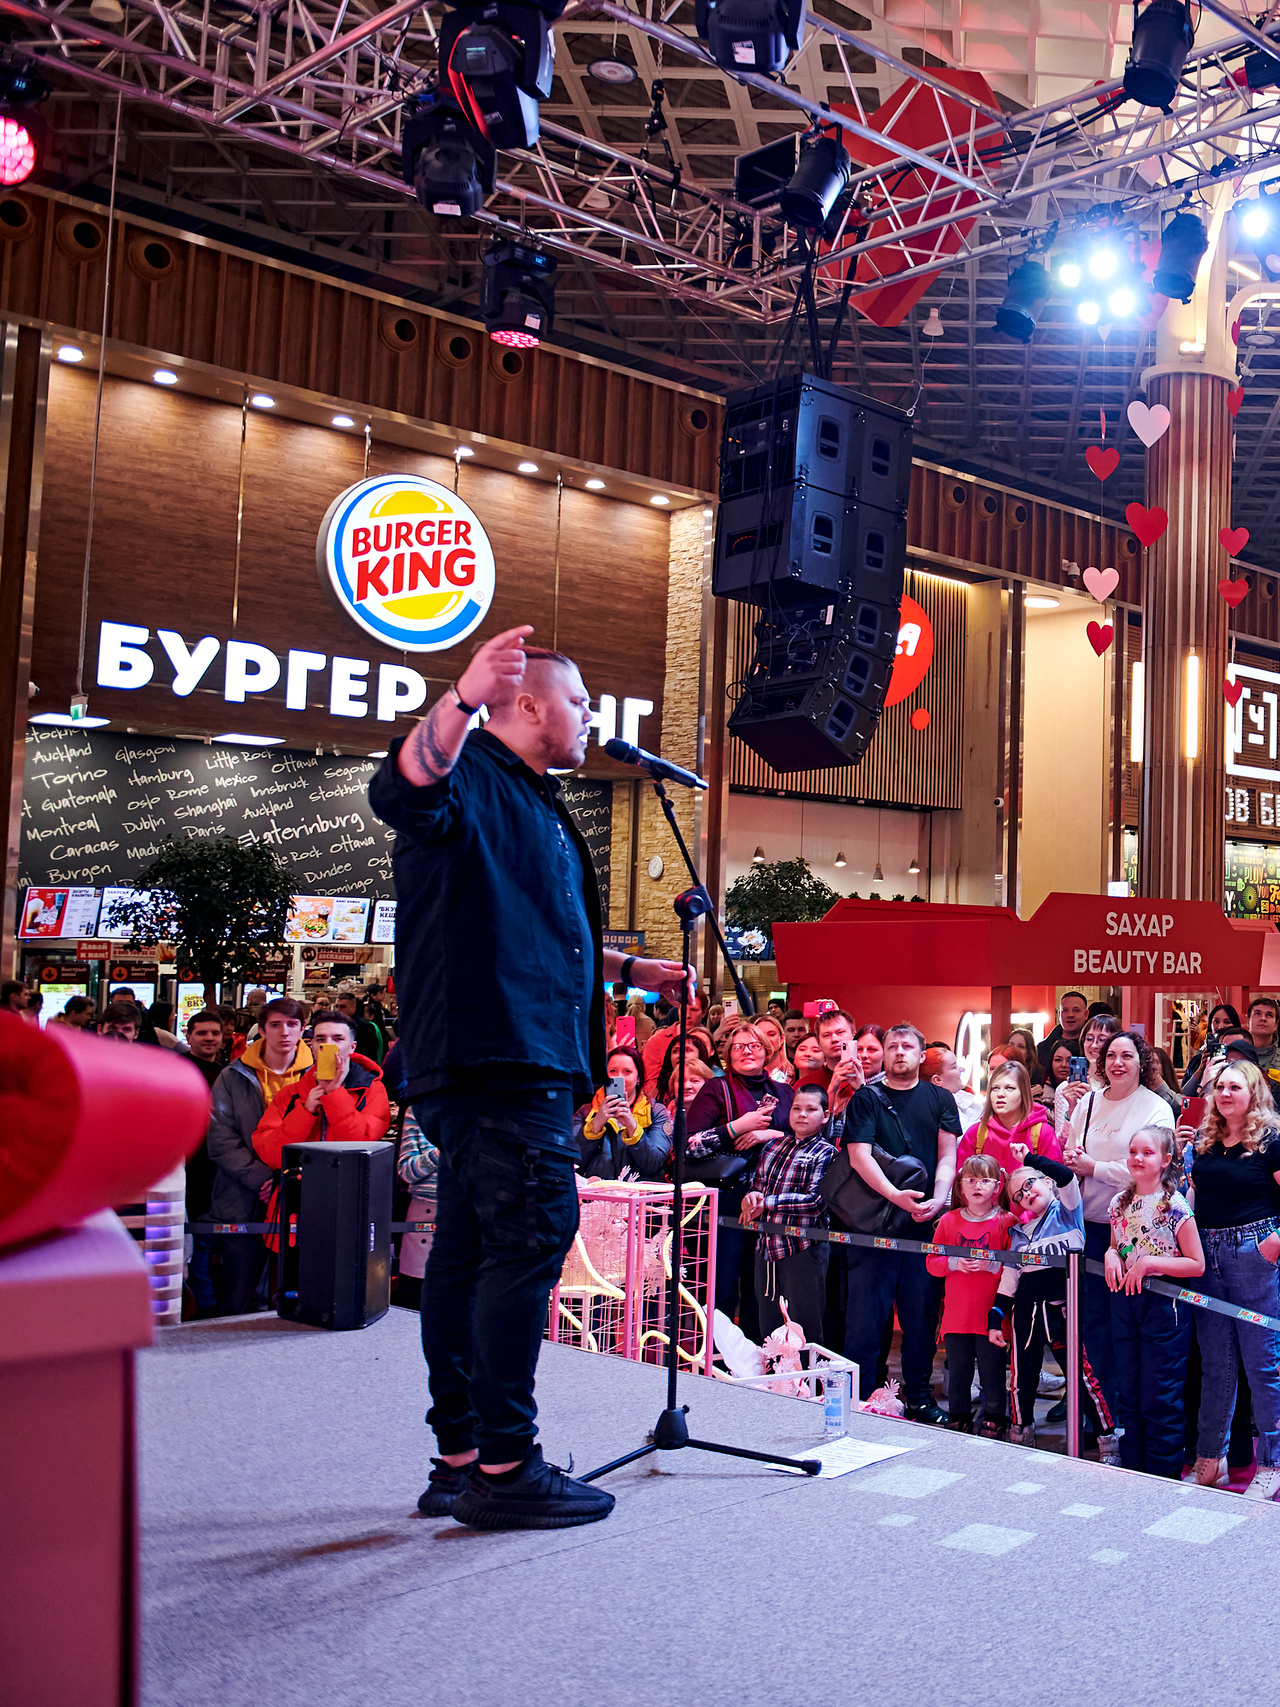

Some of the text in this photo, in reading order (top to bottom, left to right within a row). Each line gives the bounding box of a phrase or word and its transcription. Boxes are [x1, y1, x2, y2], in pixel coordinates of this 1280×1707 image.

[352, 520, 471, 559] BURGER
[356, 549, 476, 601] KING
[97, 621, 428, 722] БУРГЕР
[32, 743, 92, 763] Auckland
[115, 744, 176, 765] Glasgow
[205, 748, 275, 770] Little Rock
[271, 754, 318, 773] Ottawa
[31, 766, 108, 788] Torino
[128, 769, 194, 788] Hamburg
[215, 773, 257, 788] Mexico
[324, 760, 374, 781] Segovia
[165, 785, 209, 801] Rome
[250, 776, 309, 798] Innsbruck
[564, 790, 603, 803] Mexico
[41, 785, 117, 813] Guatemala
[127, 794, 160, 810] Oslo
[174, 793, 238, 820] Shanghai
[242, 797, 294, 819] Auckland
[569, 803, 610, 818] Torin
[26, 813, 100, 841] Montreal
[122, 815, 166, 834] Dublin
[182, 822, 226, 839] Paris
[50, 839, 119, 860] Caracas
[127, 839, 174, 860] Madri
[290, 846, 323, 862] Rock
[329, 834, 375, 854] Ottawa
[367, 851, 393, 868] Osl
[303, 861, 352, 884] Dundee
[1074, 949, 1202, 974] BEAUTY BAR
